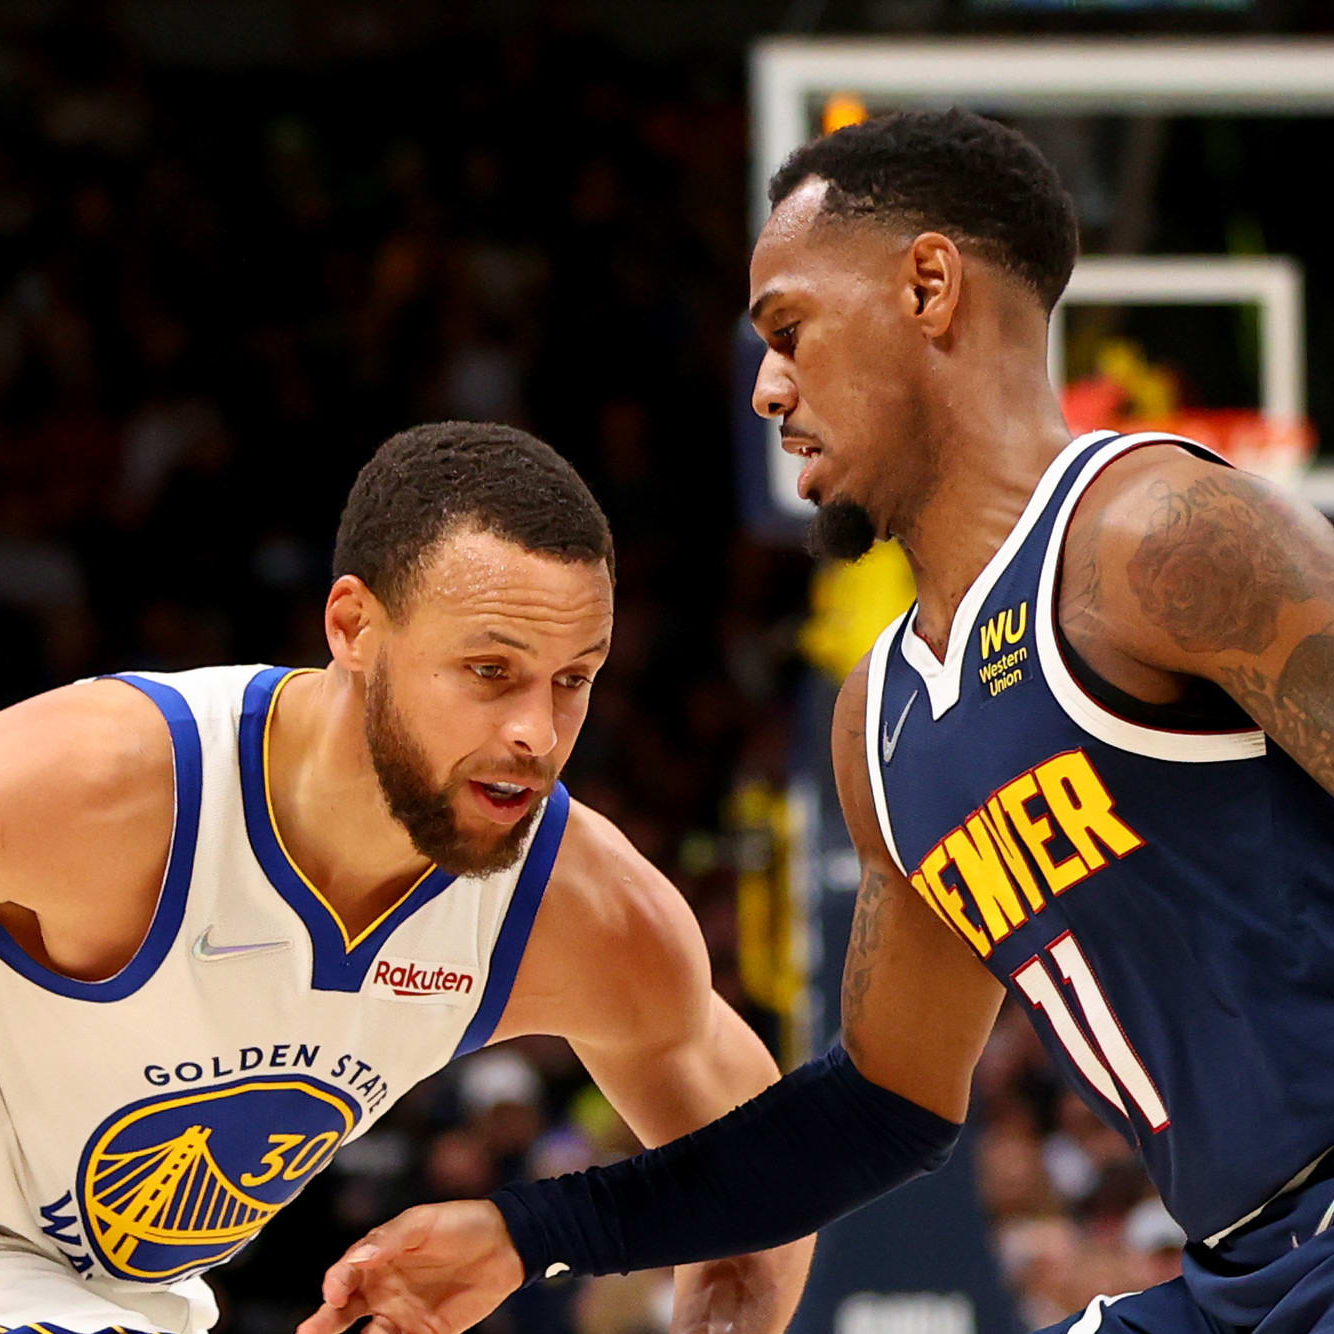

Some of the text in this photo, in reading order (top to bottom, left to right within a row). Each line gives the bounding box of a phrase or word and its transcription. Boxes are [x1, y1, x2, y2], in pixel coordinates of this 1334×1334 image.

[980, 601, 1027, 660] WU
[979, 647, 1027, 684] Western
[989, 668, 1022, 697] Union
[373, 960, 474, 995] Rakuten
[1009, 928, 1171, 1142] 11
[144, 1044, 322, 1087] GOLDEN
[240, 1131, 339, 1188] 30
